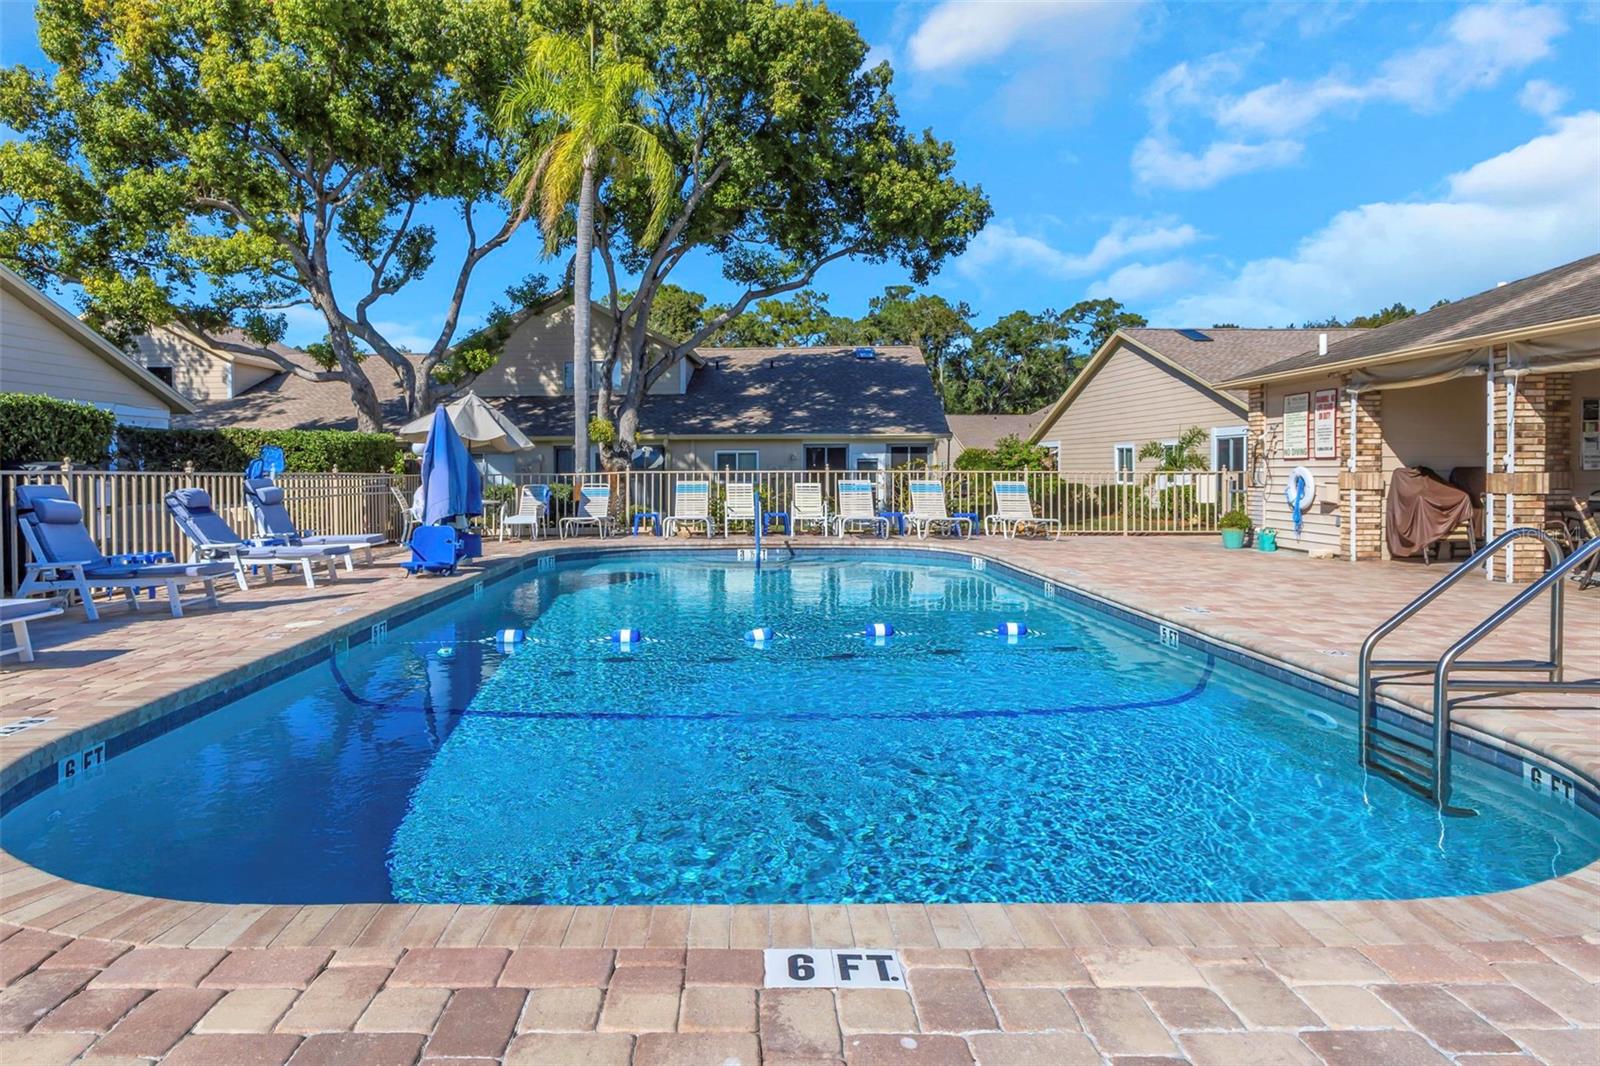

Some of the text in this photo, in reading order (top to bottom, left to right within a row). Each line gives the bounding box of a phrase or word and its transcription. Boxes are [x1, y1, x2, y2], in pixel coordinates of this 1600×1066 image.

[83, 746, 104, 770] FT
[1551, 774, 1573, 800] FT
[786, 953, 900, 982] 6 FT.
